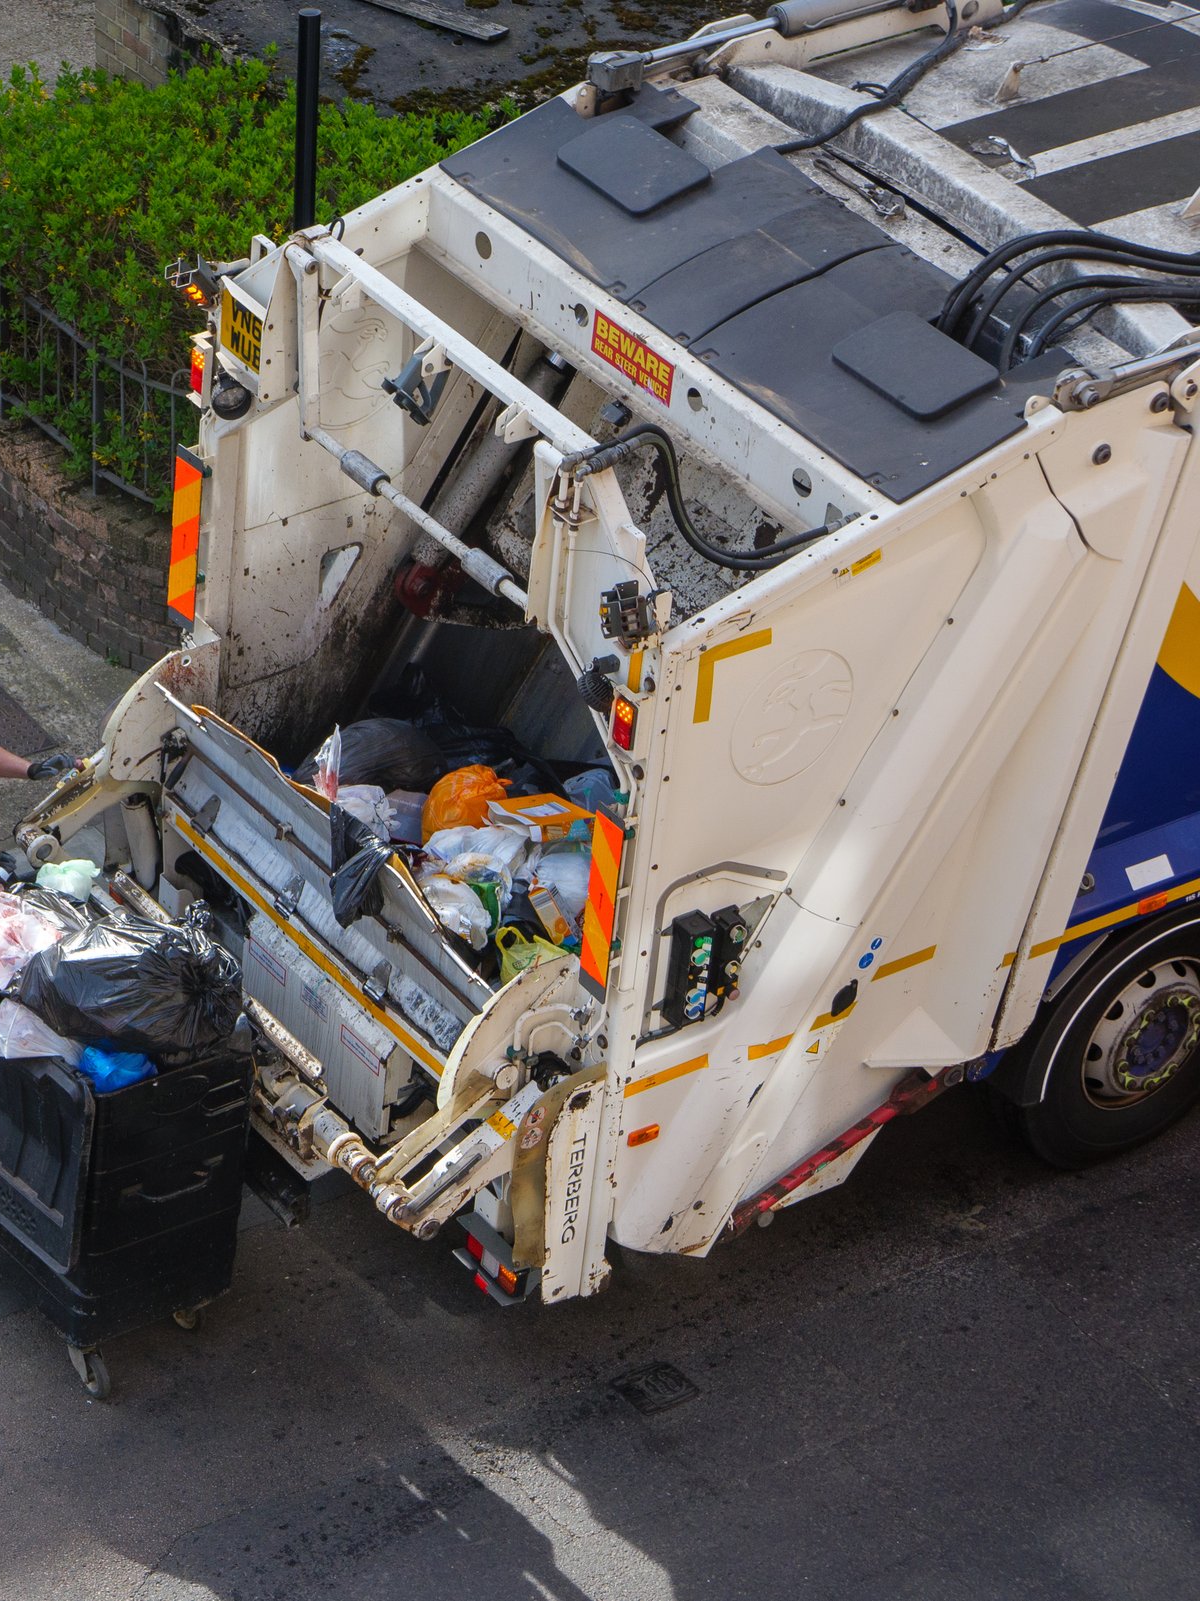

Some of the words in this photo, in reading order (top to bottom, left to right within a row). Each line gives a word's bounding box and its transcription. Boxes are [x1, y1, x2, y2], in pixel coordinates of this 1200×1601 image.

[594, 339, 613, 360] REAR
[615, 354, 637, 378] STEER
[639, 371, 668, 401] VEHICLE
[596, 315, 671, 386] BEWARE
[561, 1132, 587, 1245] TERBERG
